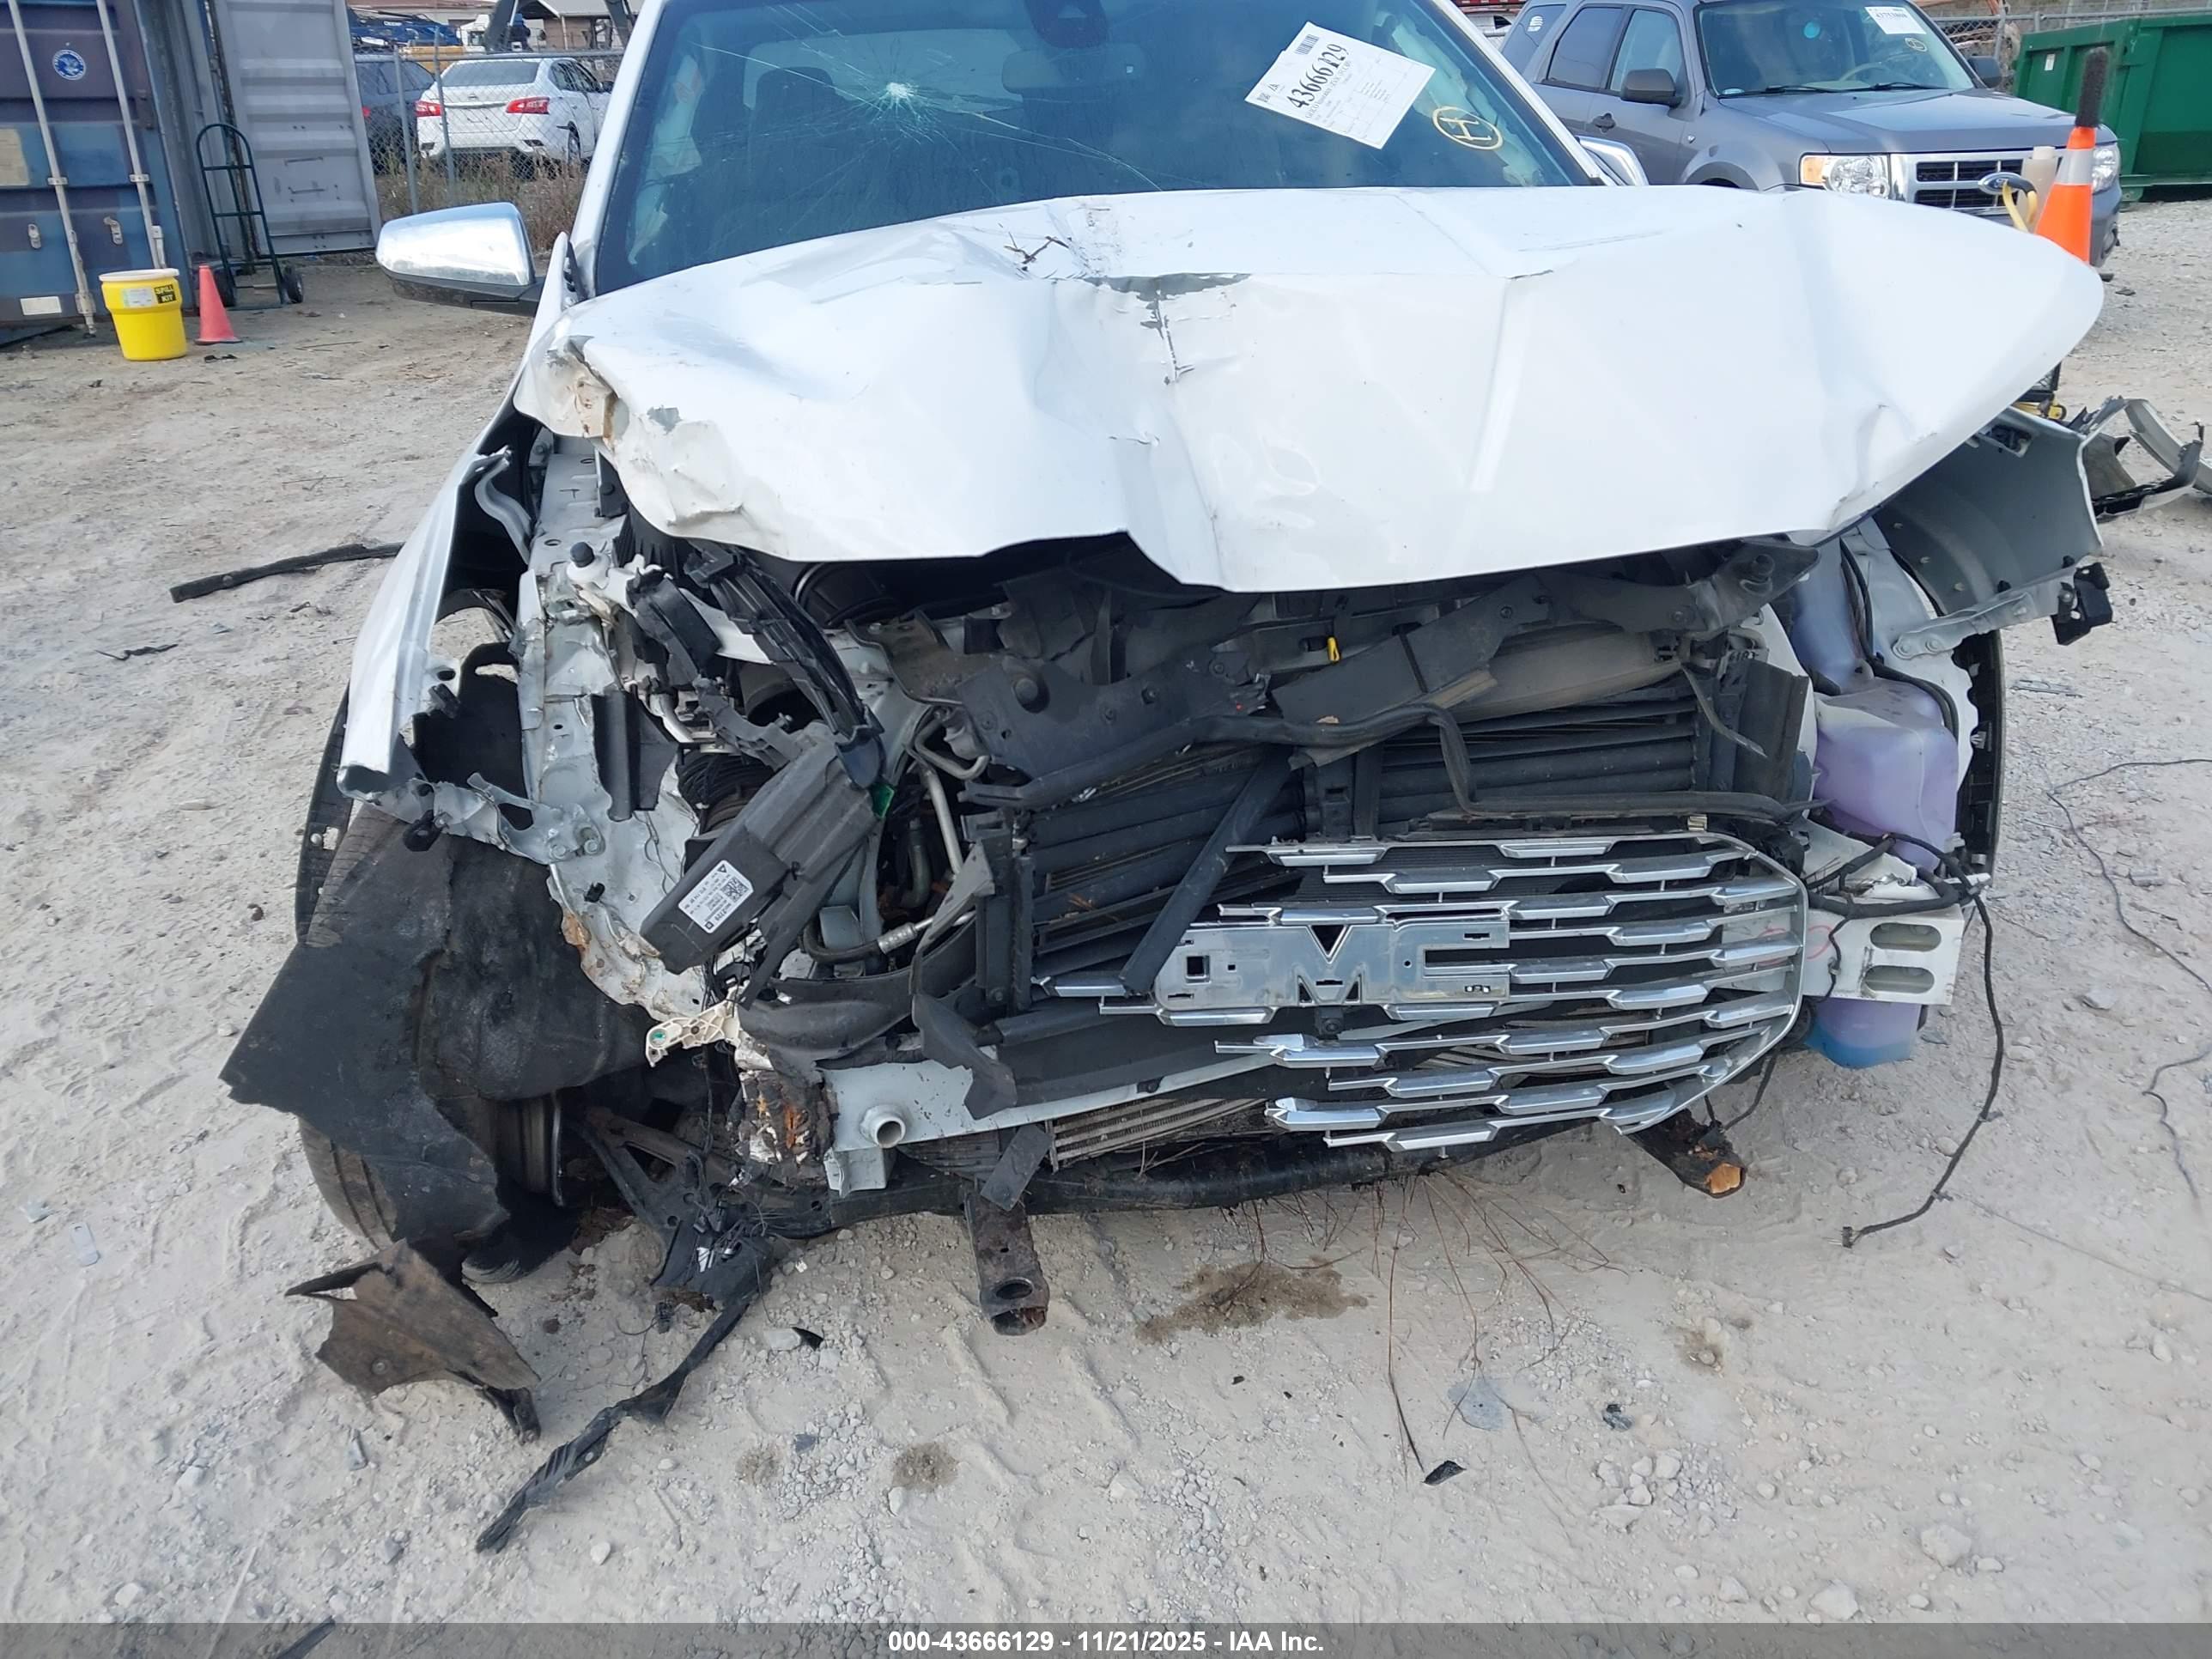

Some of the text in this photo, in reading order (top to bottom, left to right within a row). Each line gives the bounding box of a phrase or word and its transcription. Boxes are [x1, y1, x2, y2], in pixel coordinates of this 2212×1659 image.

[1285, 43, 1350, 109] 43666129
[155, 284, 174, 295] SPILL
[160, 295, 174, 303] KIT
